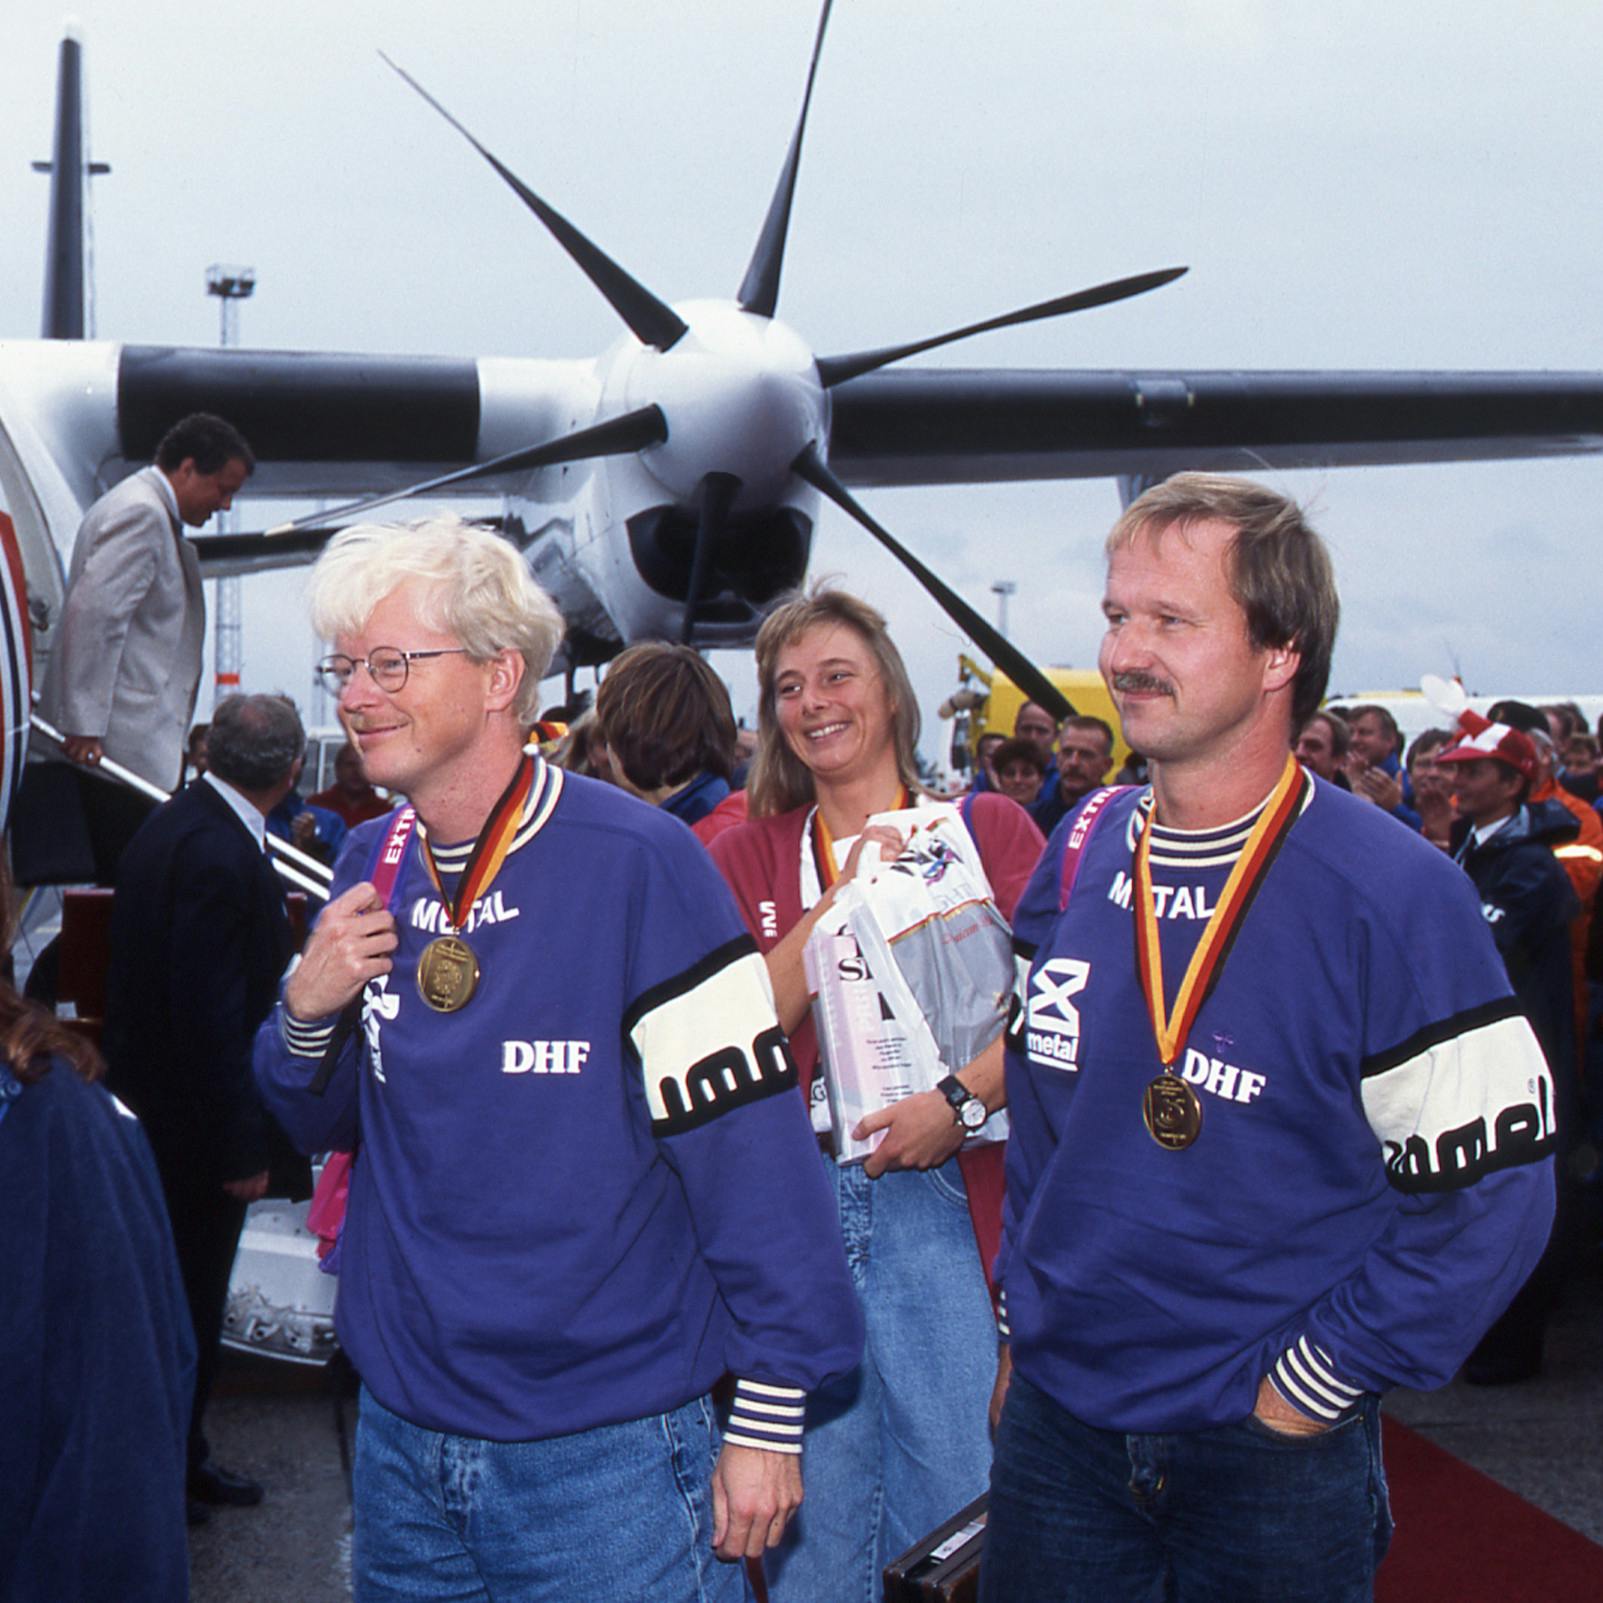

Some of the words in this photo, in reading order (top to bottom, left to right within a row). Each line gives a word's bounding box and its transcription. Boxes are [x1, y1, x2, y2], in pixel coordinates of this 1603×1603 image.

[1107, 870, 1216, 920] MTAL
[502, 1040, 590, 1074] DHF
[1028, 1031, 1079, 1063] metal
[1182, 1047, 1266, 1104] DHF
